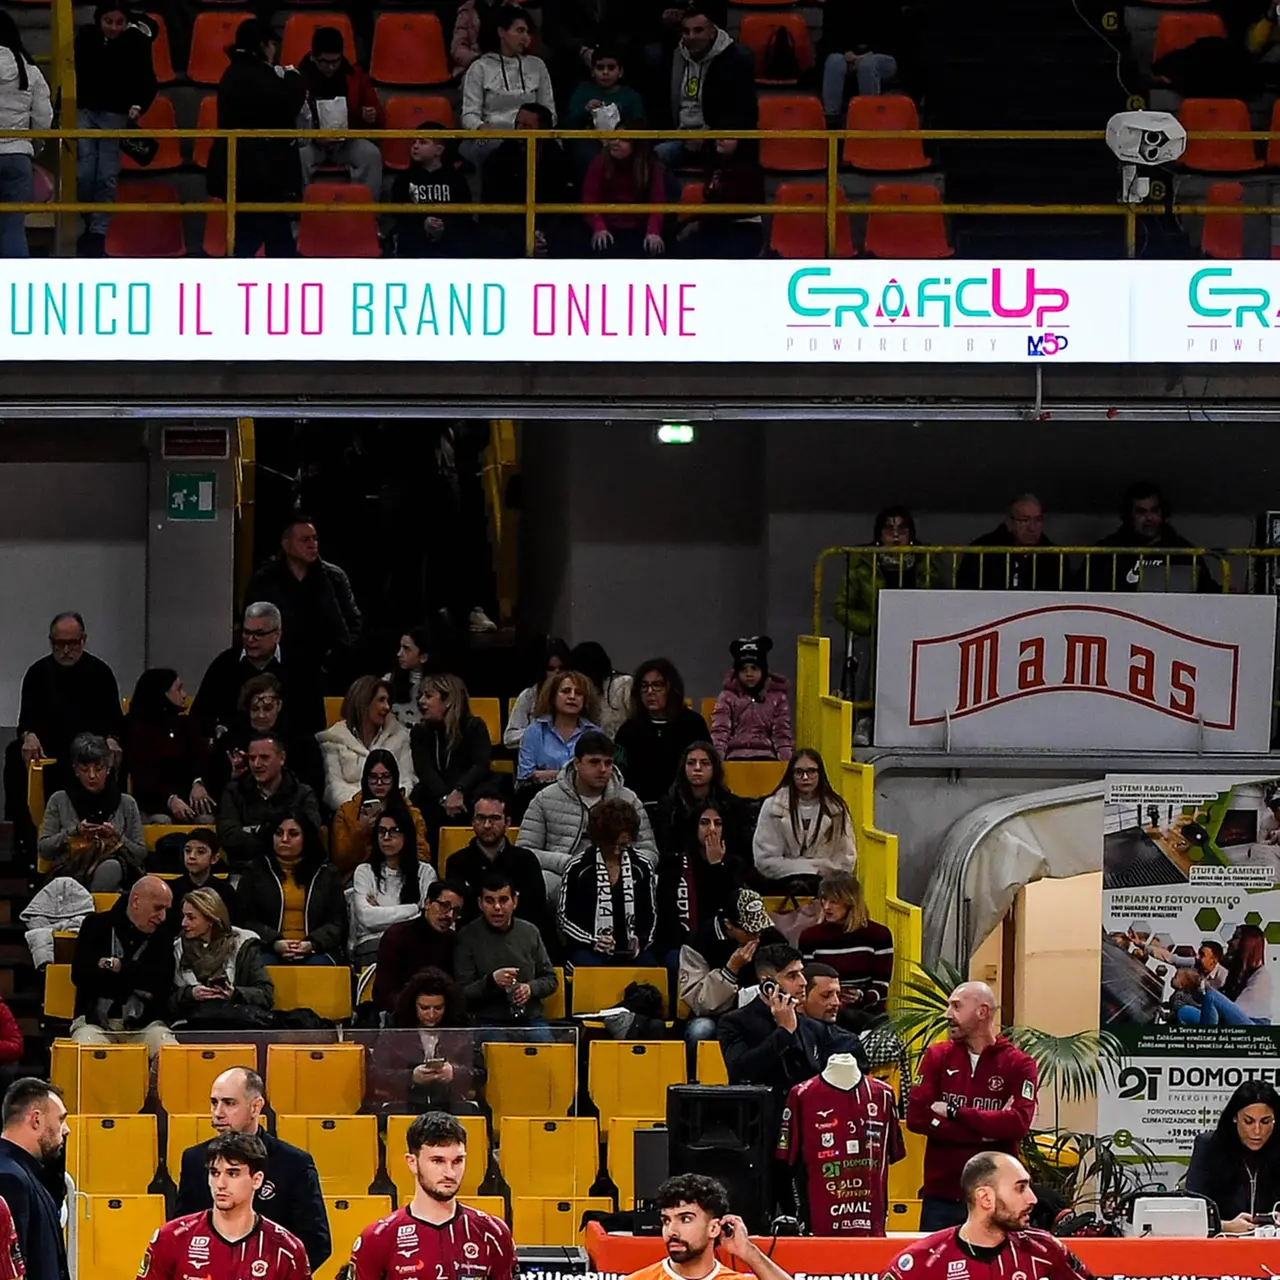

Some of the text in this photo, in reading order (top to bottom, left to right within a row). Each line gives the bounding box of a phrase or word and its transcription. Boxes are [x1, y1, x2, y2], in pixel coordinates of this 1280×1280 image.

[11, 282, 151, 335] UNICO
[179, 283, 212, 335] IL
[238, 283, 323, 335] TUO
[352, 282, 506, 336] BRAND
[533, 283, 696, 336] ONLINE
[787, 338, 997, 352] POWERED BY
[1111, 895, 1240, 904] IMPIANTO FOTOVOLTAICO
[1169, 1067, 1280, 1089] DOMOTE
[847, 1120, 857, 1134] 3
[435, 1264, 449, 1280] 2
